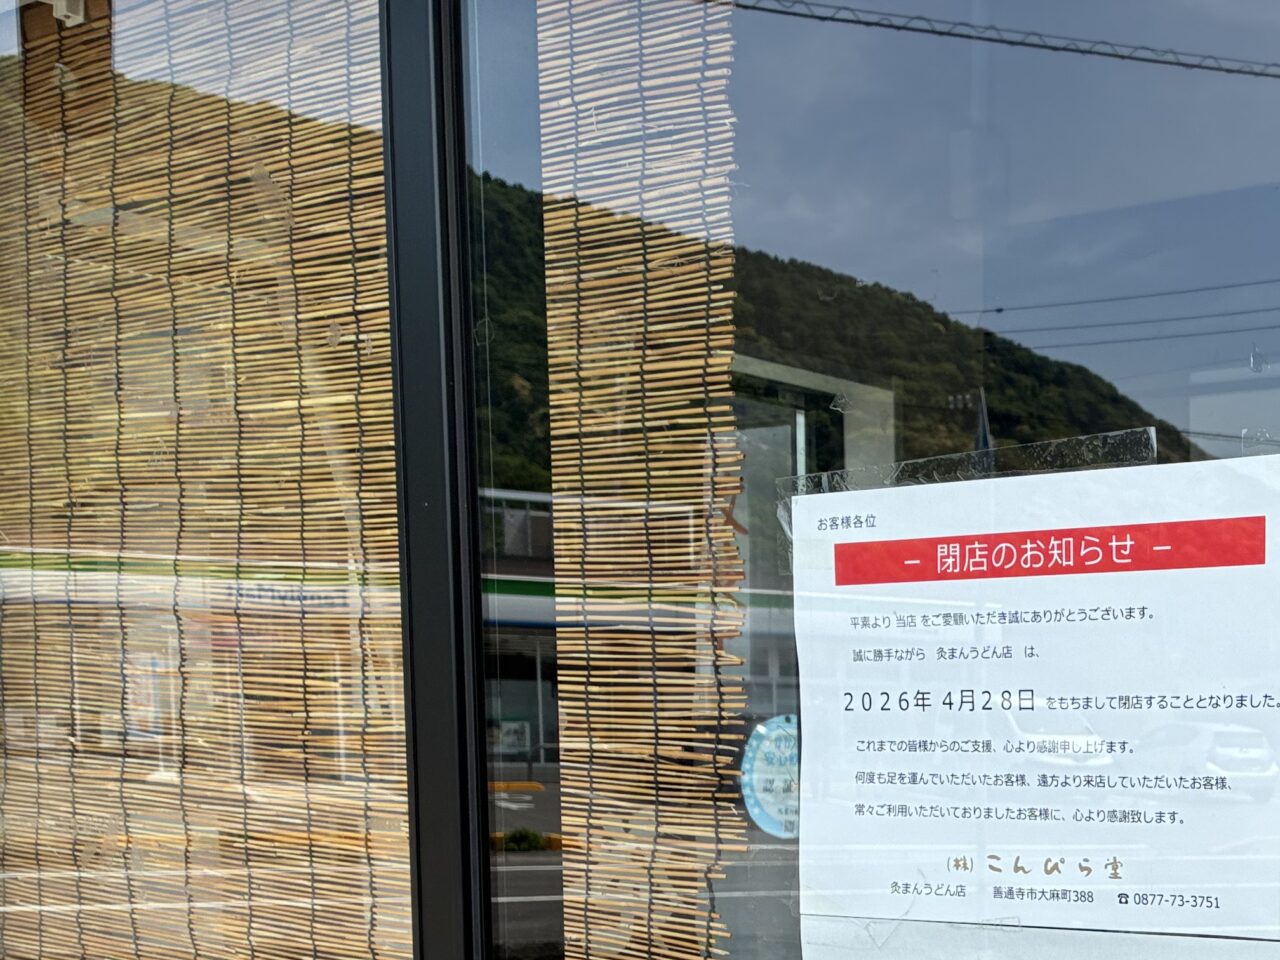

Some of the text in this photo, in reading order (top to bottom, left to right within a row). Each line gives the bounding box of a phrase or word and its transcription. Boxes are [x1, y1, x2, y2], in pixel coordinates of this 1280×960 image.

[817, 513, 877, 531] お客様各位
[890, 881, 966, 898] 灸まんうどん店
[1133, 893, 1221, 909] 0877-73-3751
